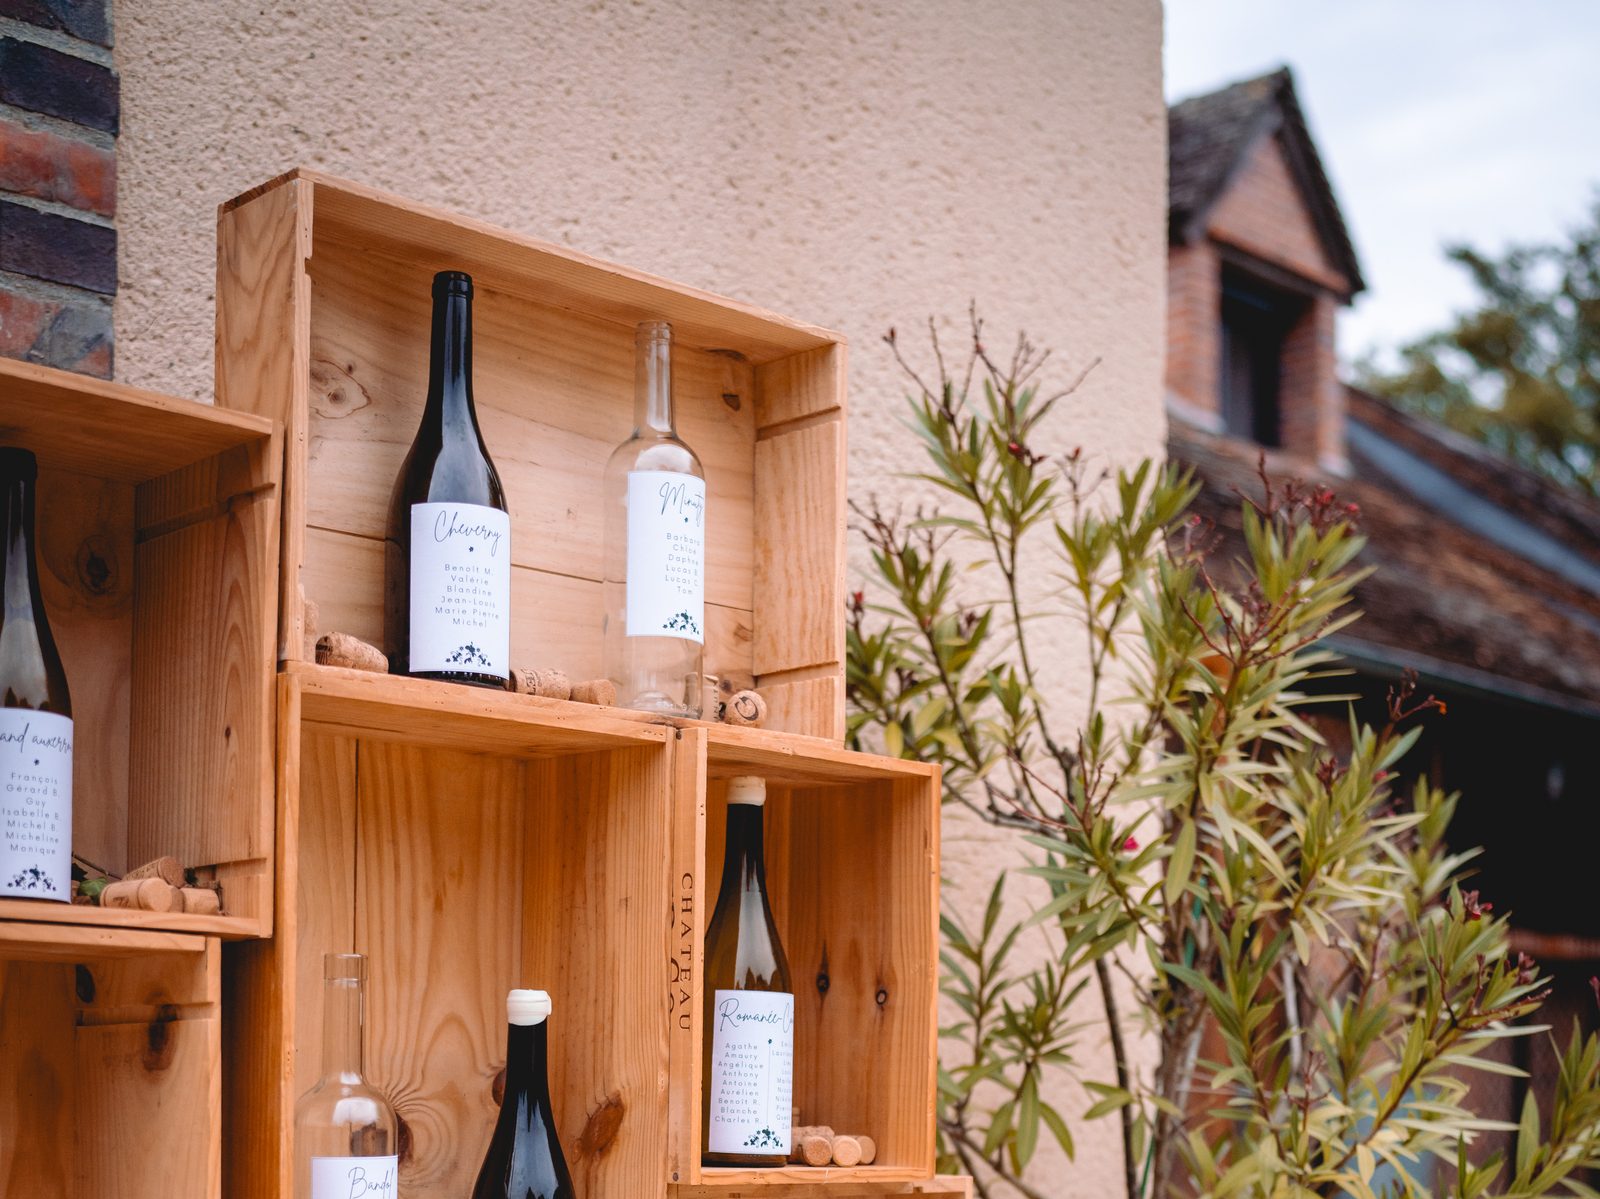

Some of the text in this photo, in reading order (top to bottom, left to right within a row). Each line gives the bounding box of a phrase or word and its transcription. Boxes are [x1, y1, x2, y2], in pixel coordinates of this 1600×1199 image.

[434, 510, 503, 557] Cheverny
[446, 584, 492, 597] Blandine
[435, 606, 467, 615] Marie
[452, 618, 487, 628] Michel
[0, 722, 30, 753] and
[26, 797, 46, 808] Guy
[2, 807, 50, 819] Isabelle
[7, 819, 46, 830] Michel
[5, 832, 59, 844] Micheline
[10, 844, 56, 856] Monique
[679, 872, 693, 1032] CHATEAU
[725, 1042, 758, 1051] Agathe
[722, 1070, 759, 1079] Anthony
[722, 1079, 758, 1088] Antoine
[720, 1106, 758, 1115] Blanche
[715, 1115, 750, 1124] Charles
